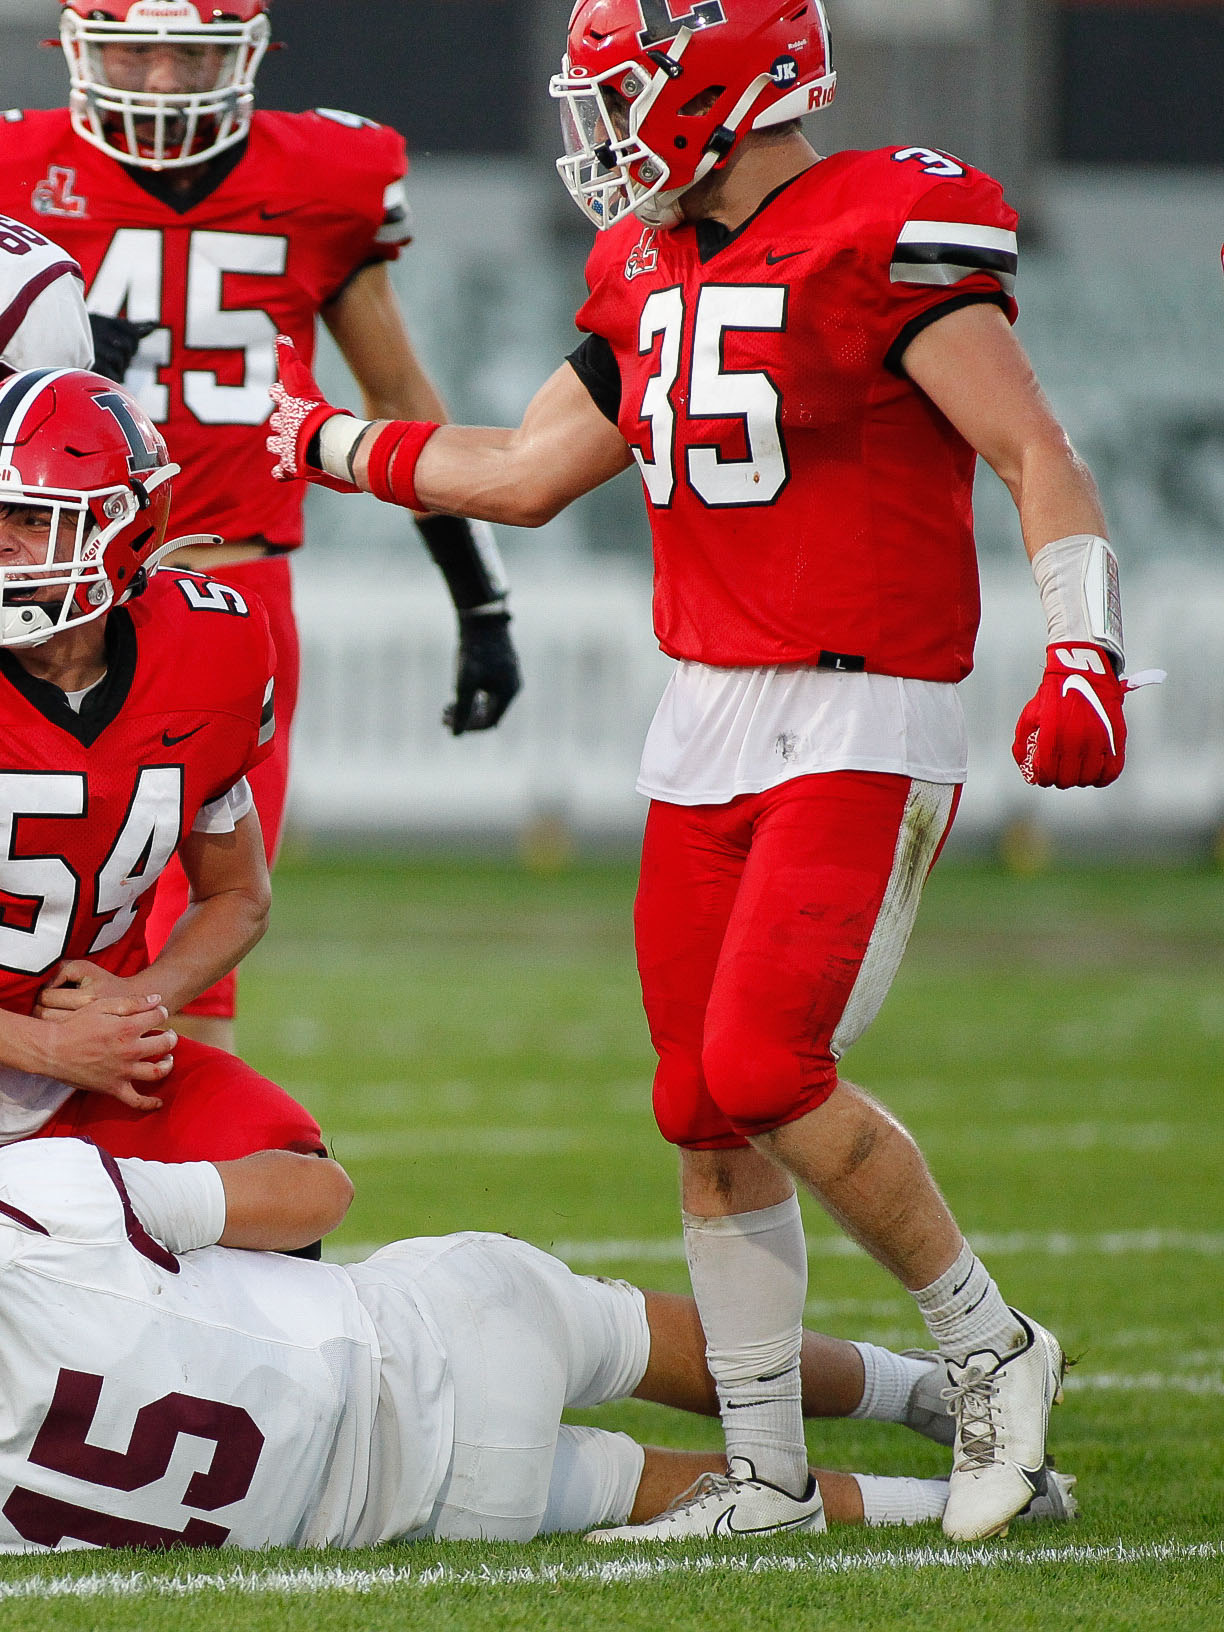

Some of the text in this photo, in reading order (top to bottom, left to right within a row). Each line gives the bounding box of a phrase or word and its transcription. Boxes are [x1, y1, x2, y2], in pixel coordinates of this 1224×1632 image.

[773, 62, 796, 82] JK
[82, 227, 289, 426] 45
[629, 282, 791, 510] 35
[1, 1366, 266, 1550] 15
